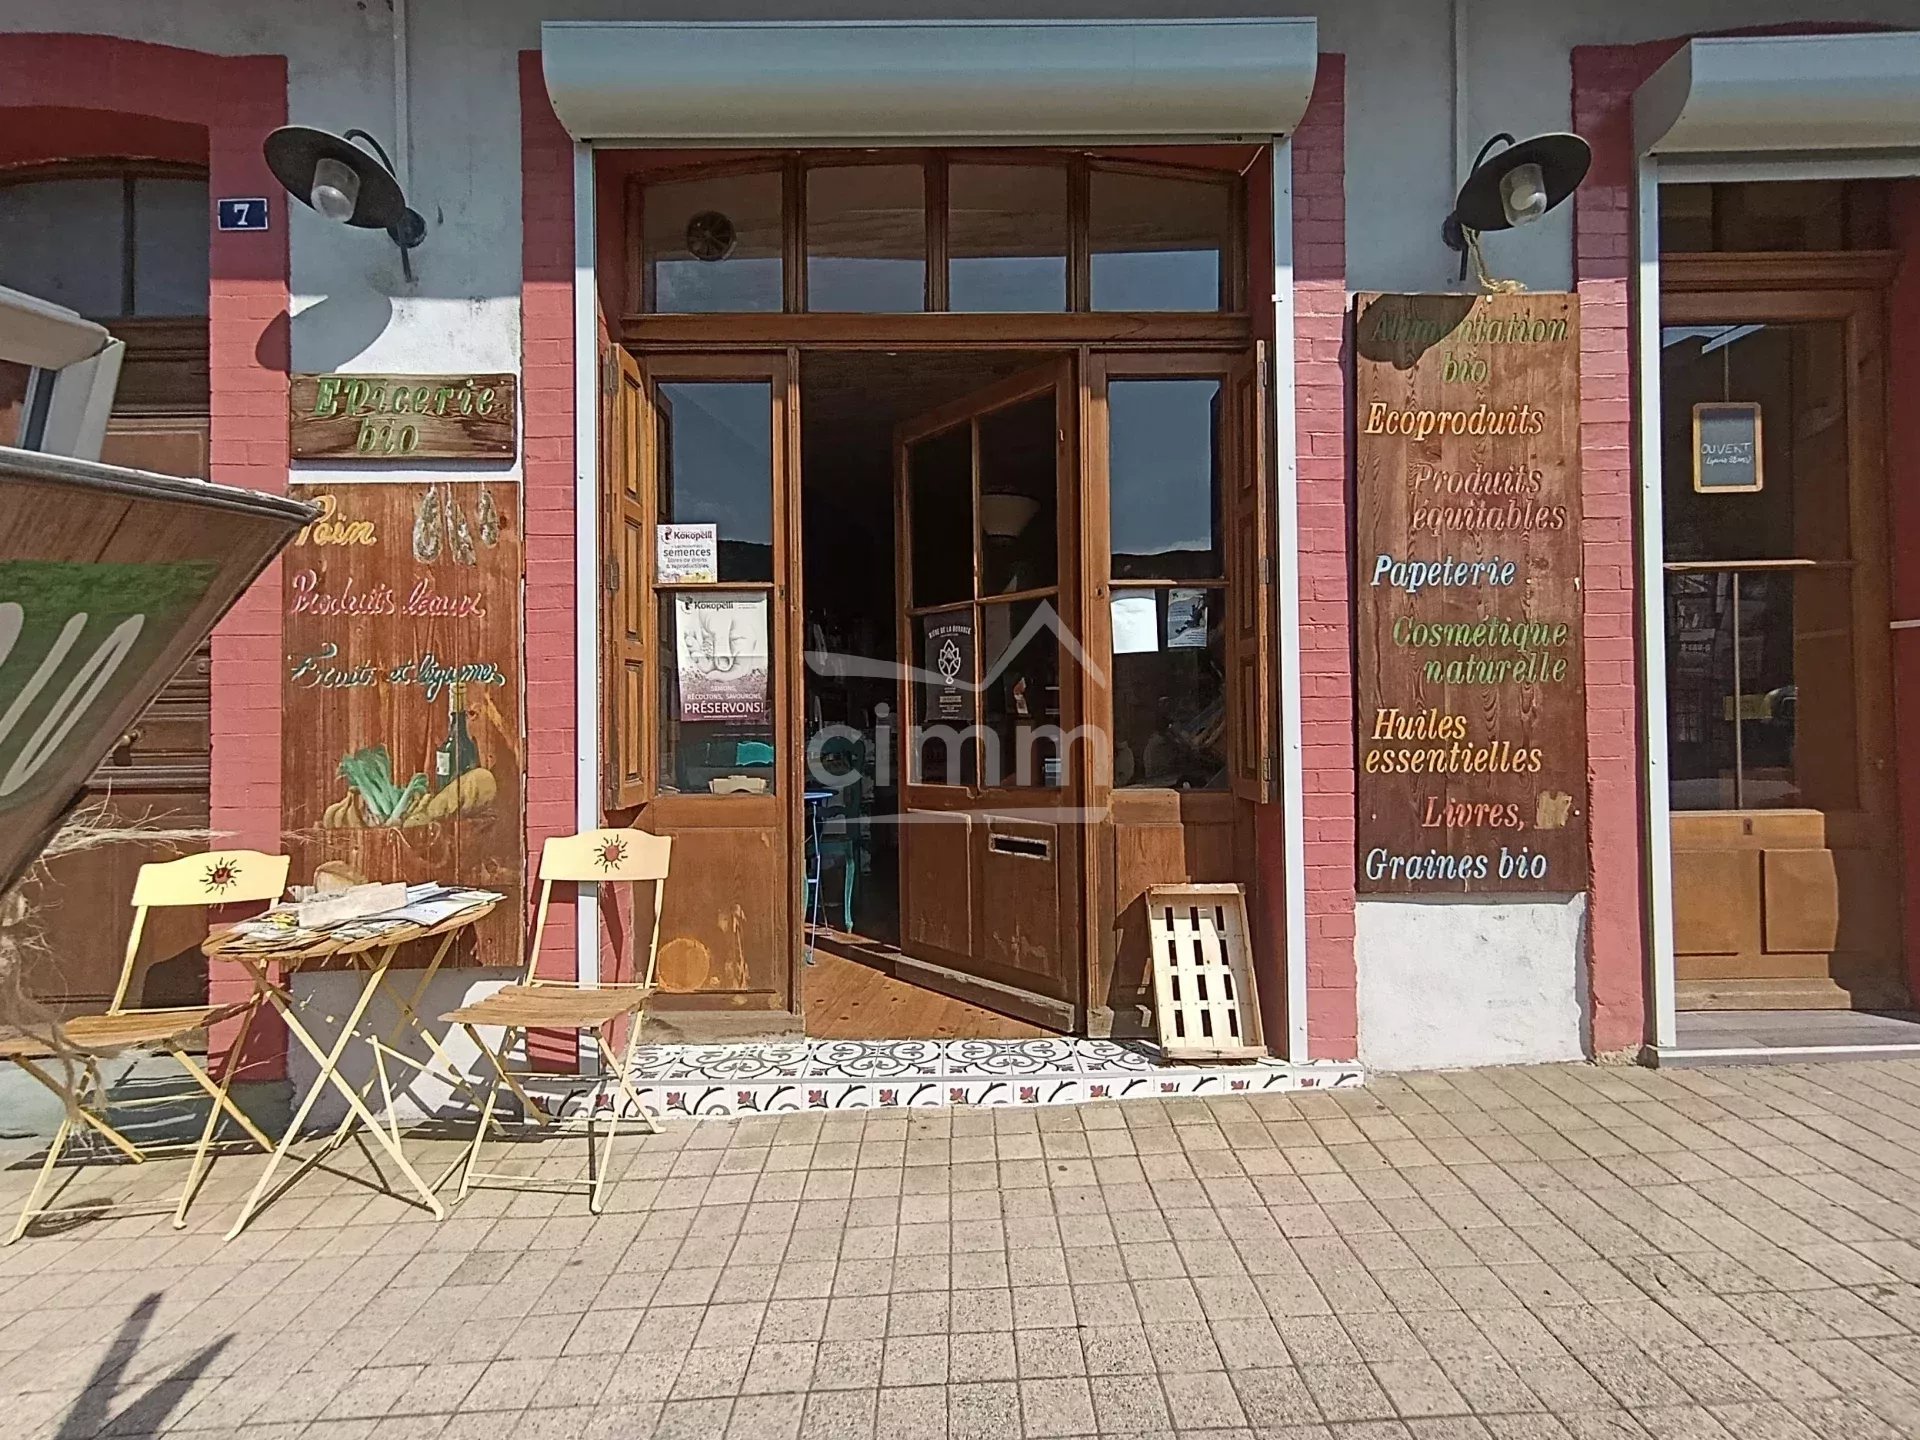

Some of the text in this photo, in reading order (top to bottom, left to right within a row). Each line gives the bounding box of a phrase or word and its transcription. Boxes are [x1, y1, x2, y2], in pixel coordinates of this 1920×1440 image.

[233, 203, 250, 226] 7
[1371, 312, 1568, 344] Alimentation
[1443, 351, 1488, 384] bio
[356, 415, 419, 455] bio
[1364, 402, 1545, 442] Ecoproduits
[1412, 462, 1542, 497] Produits
[1413, 499, 1567, 536] équitables
[673, 530, 713, 541] Kokopelli
[663, 548, 711, 557] semences
[1370, 554, 1516, 593] Papeterie
[1393, 614, 1568, 653] Cosmétique
[1423, 653, 1568, 685] naturelle
[684, 701, 764, 714] PRÉSERVONS!
[1371, 708, 1467, 741] Huiles
[1365, 741, 1543, 774] essentielles
[1421, 796, 1526, 832] Livres,
[1365, 847, 1548, 881] Graines bio
